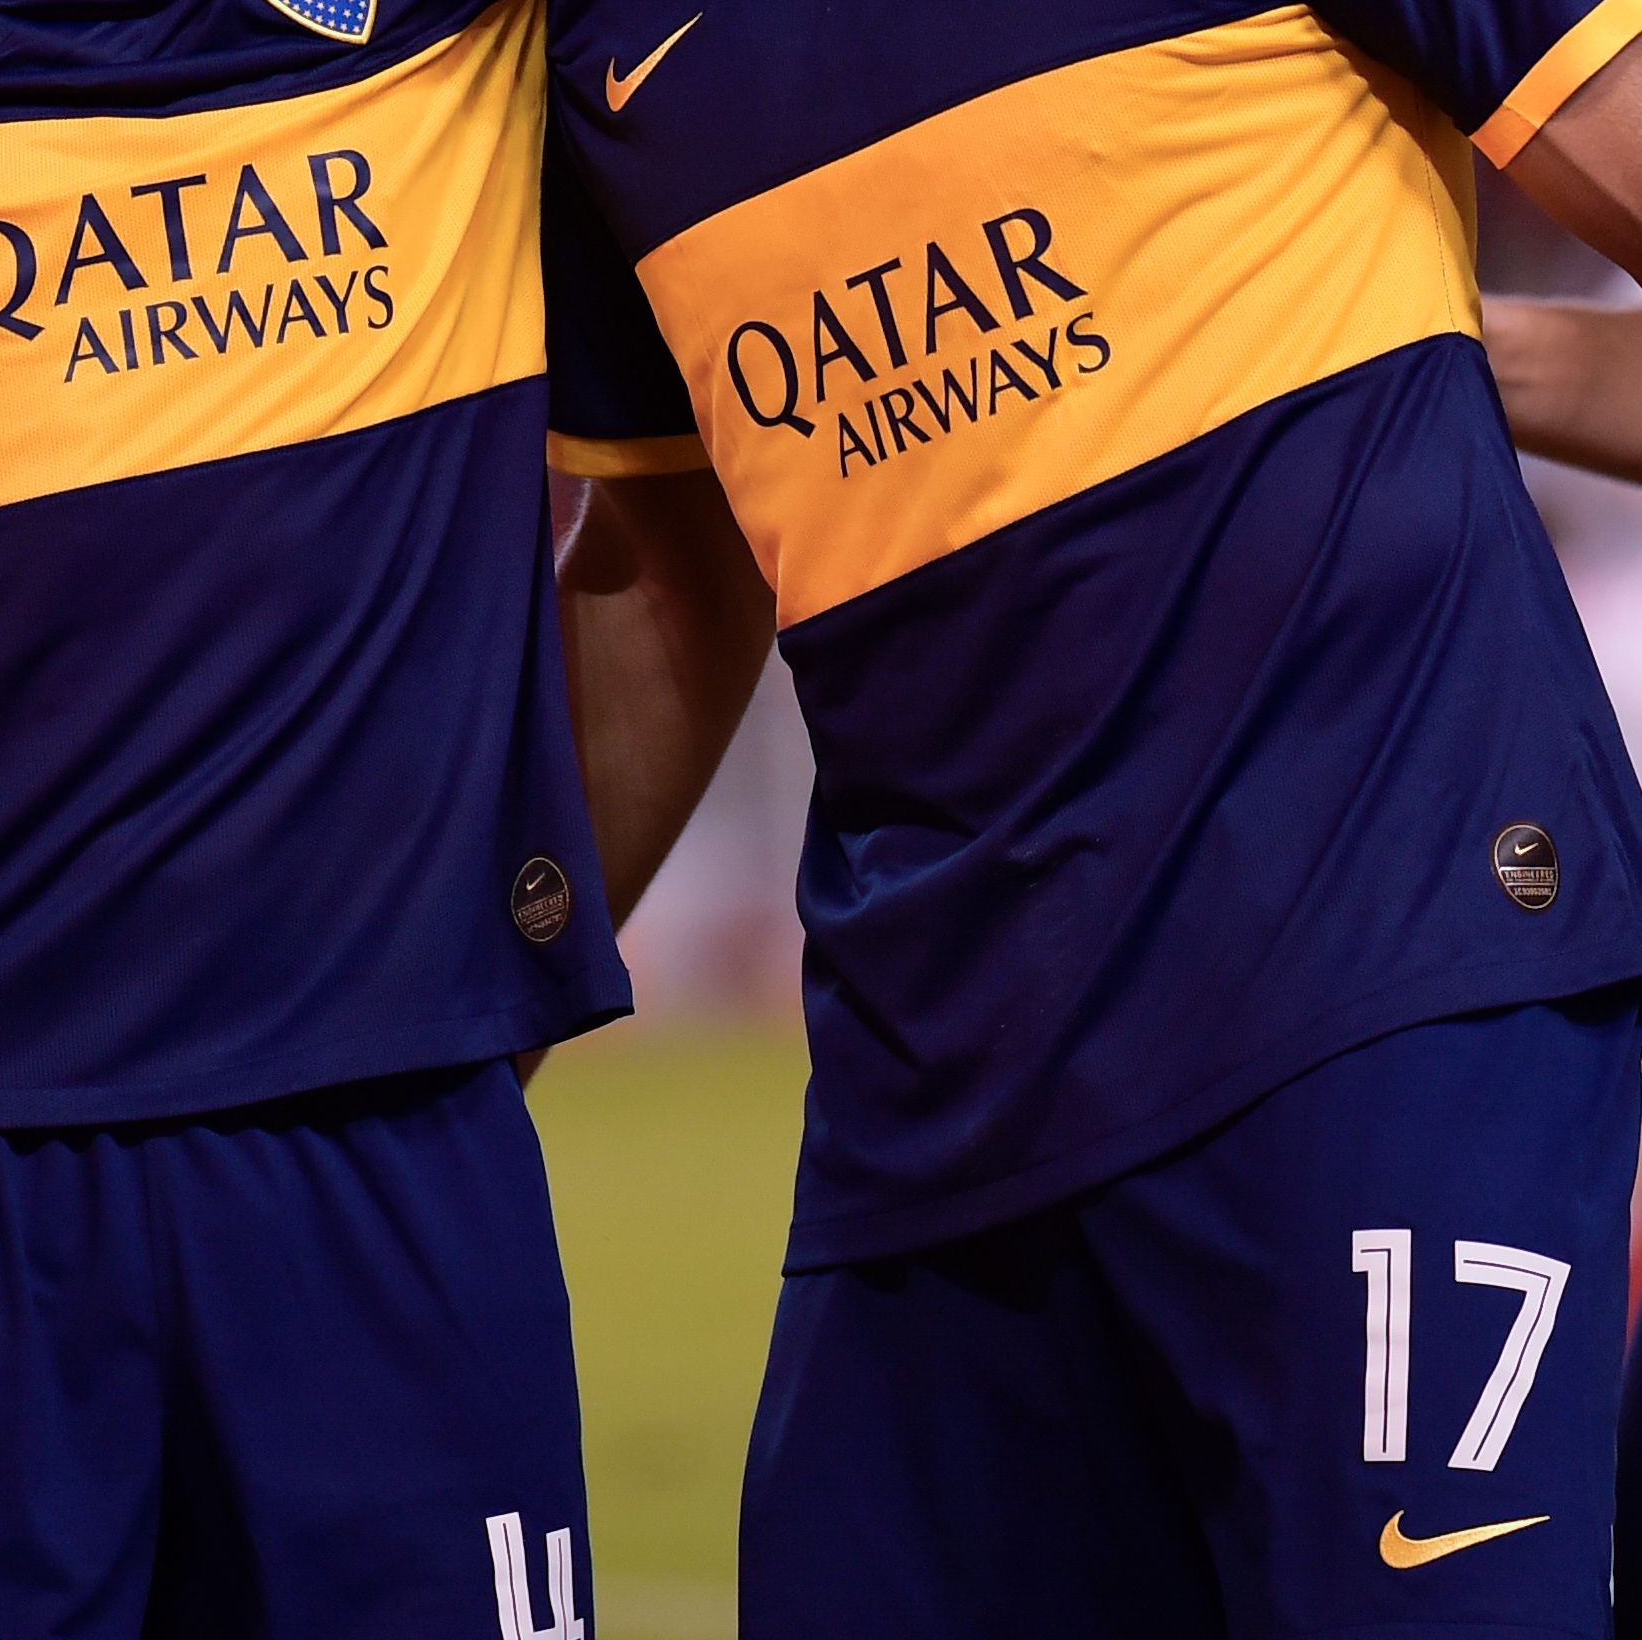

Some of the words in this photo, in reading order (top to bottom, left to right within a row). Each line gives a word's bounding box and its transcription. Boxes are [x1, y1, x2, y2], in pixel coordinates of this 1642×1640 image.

[62, 265, 395, 384] AIRWAYS
[726, 206, 1089, 439] QATAR
[837, 310, 1113, 479] AIRWAYS
[1352, 1228, 1571, 1472] 17
